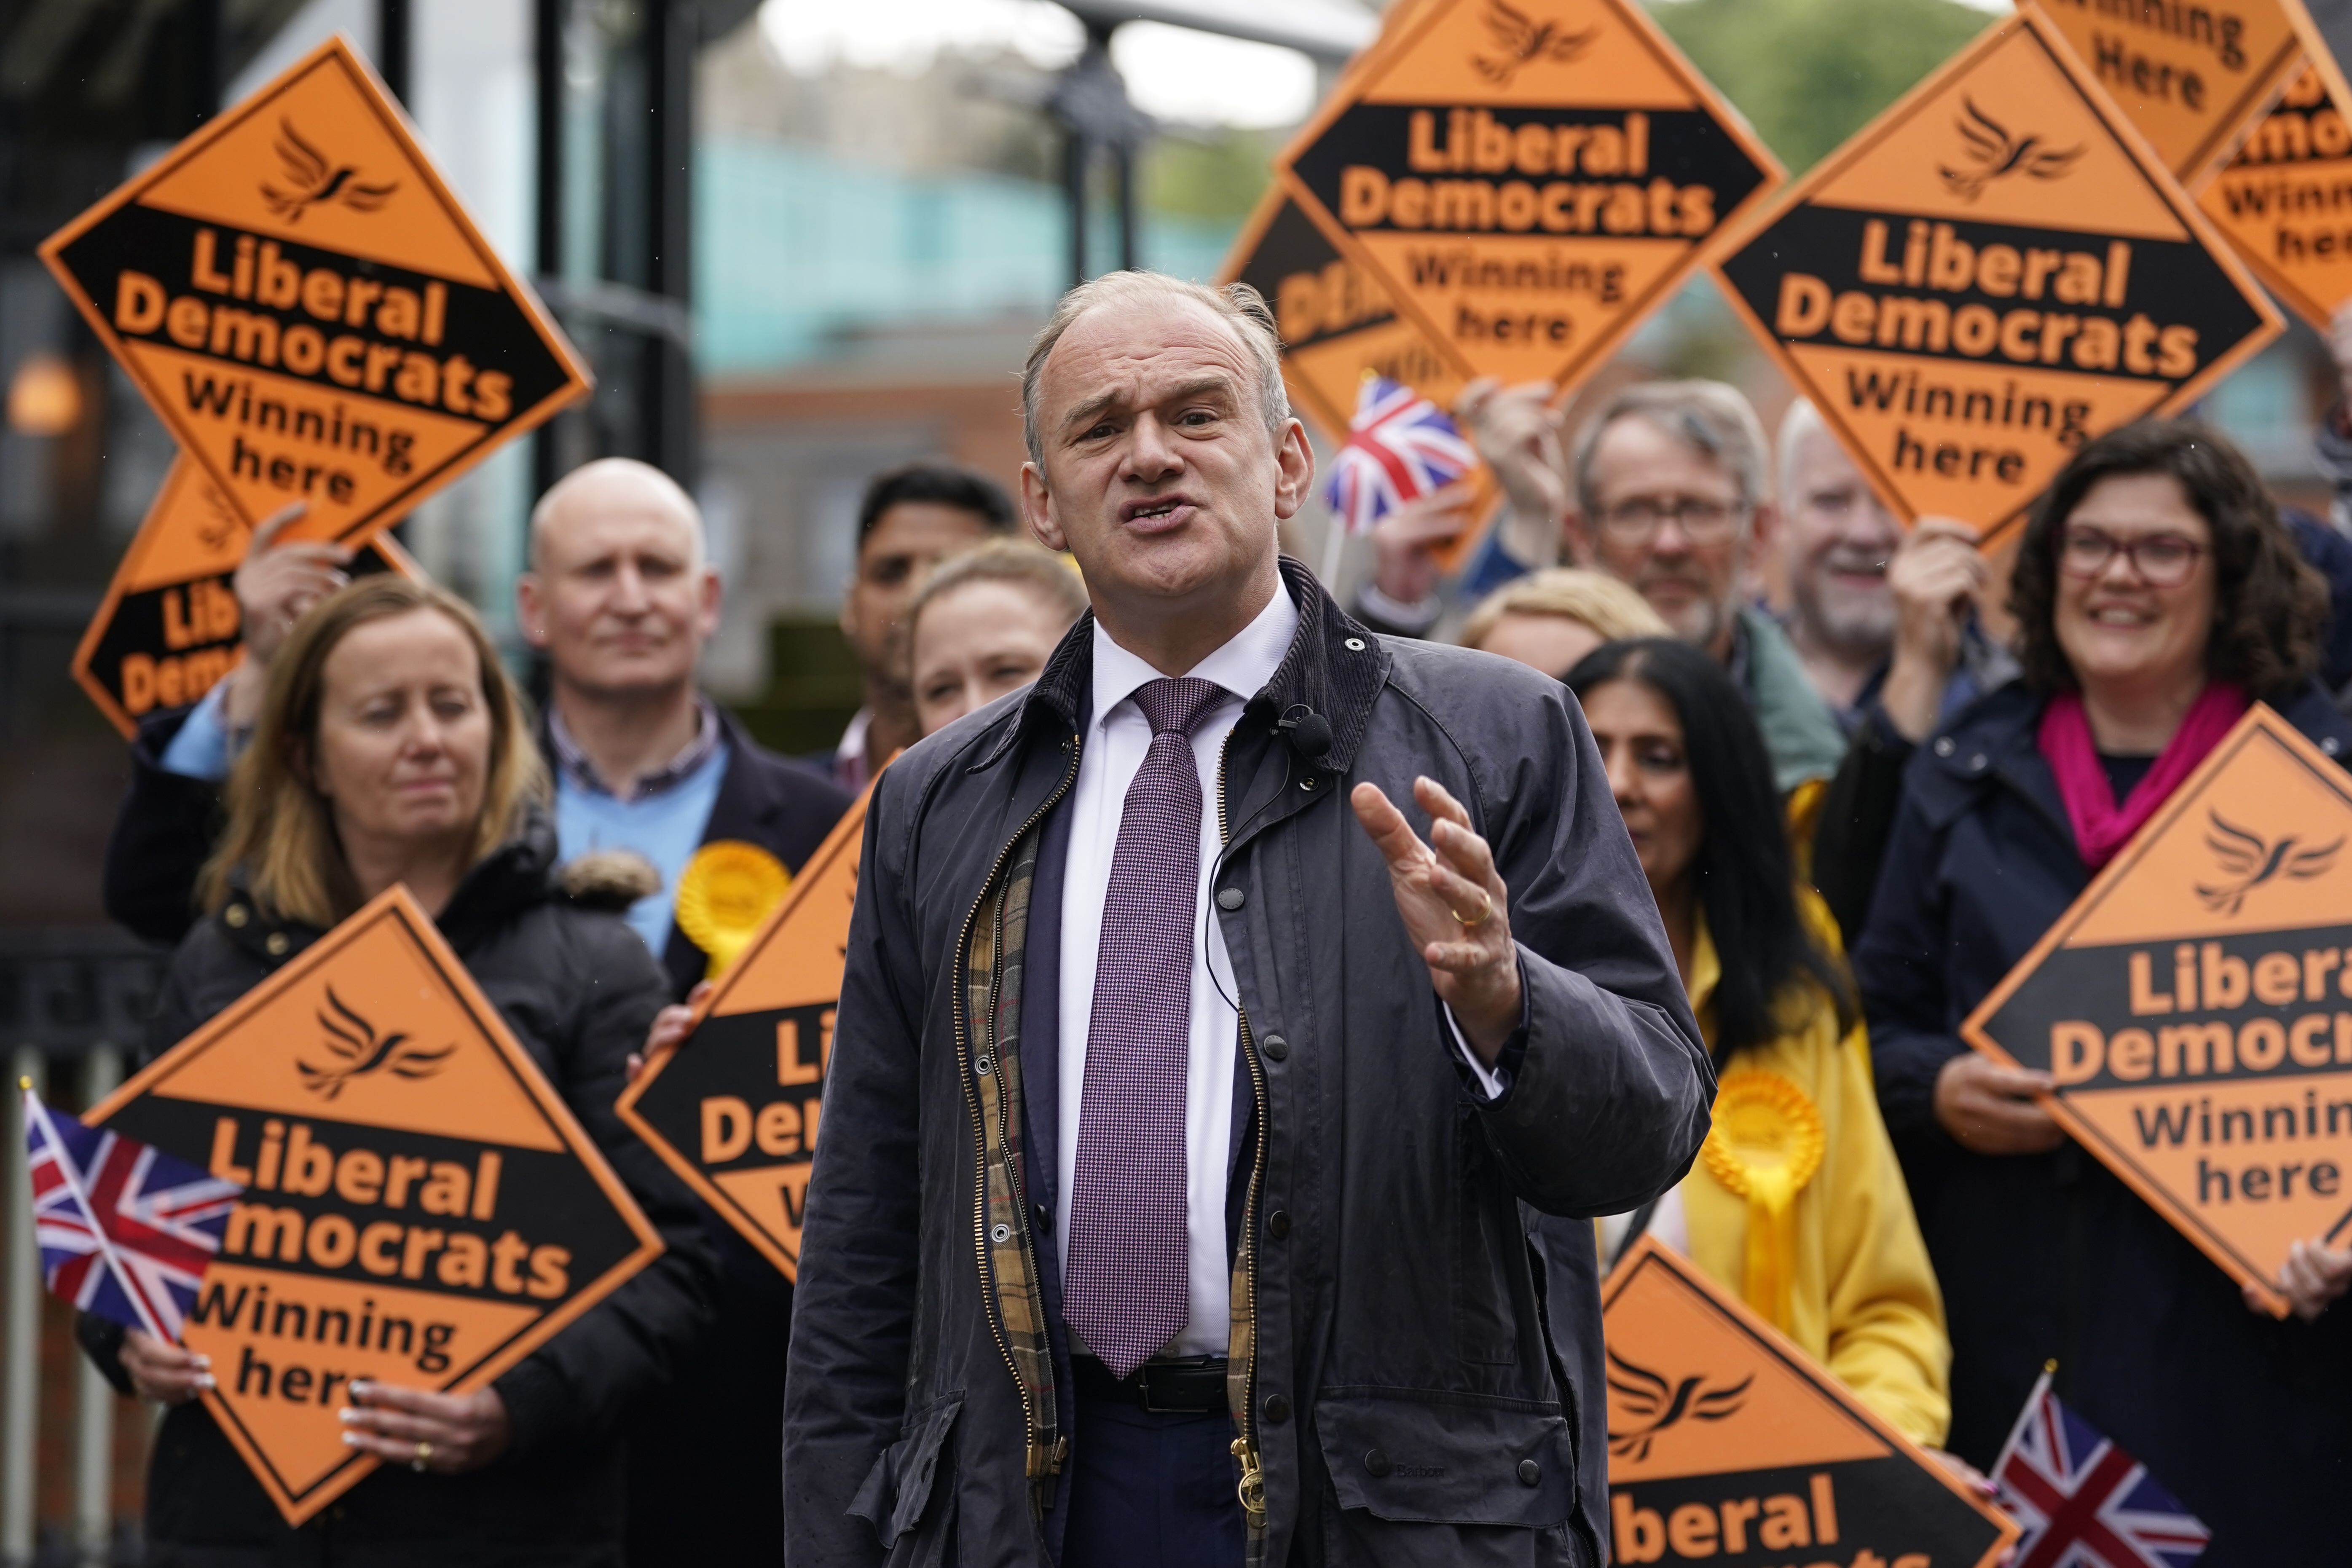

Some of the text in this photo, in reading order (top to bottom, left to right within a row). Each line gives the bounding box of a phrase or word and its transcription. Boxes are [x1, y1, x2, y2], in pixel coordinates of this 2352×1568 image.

[2057, 0, 2247, 70] nning
[1409, 108, 1649, 176] Liberal
[1340, 166, 1716, 236] Democrats
[2223, 179, 2352, 216] Winn
[192, 230, 447, 345] Liberal
[1405, 248, 1627, 304] Winning
[1859, 218, 2132, 308] Liberal
[116, 269, 514, 421] Democrats
[1454, 301, 1573, 346] here
[1776, 272, 2199, 378] Democrats
[183, 370, 416, 478] Winning
[1846, 365, 2094, 448] Winning
[231, 440, 356, 504] here
[1893, 431, 2026, 485] here
[2129, 941, 2352, 1014] Liber
[2050, 1011, 2352, 1083] Democ
[2133, 1091, 2352, 1148] Winnin
[210, 1118, 502, 1220] Liberal
[2198, 1158, 2340, 1204] here
[223, 1201, 571, 1298] mocrats
[193, 1279, 456, 1375] Winning
[1608, 1473, 1840, 1564] beral
